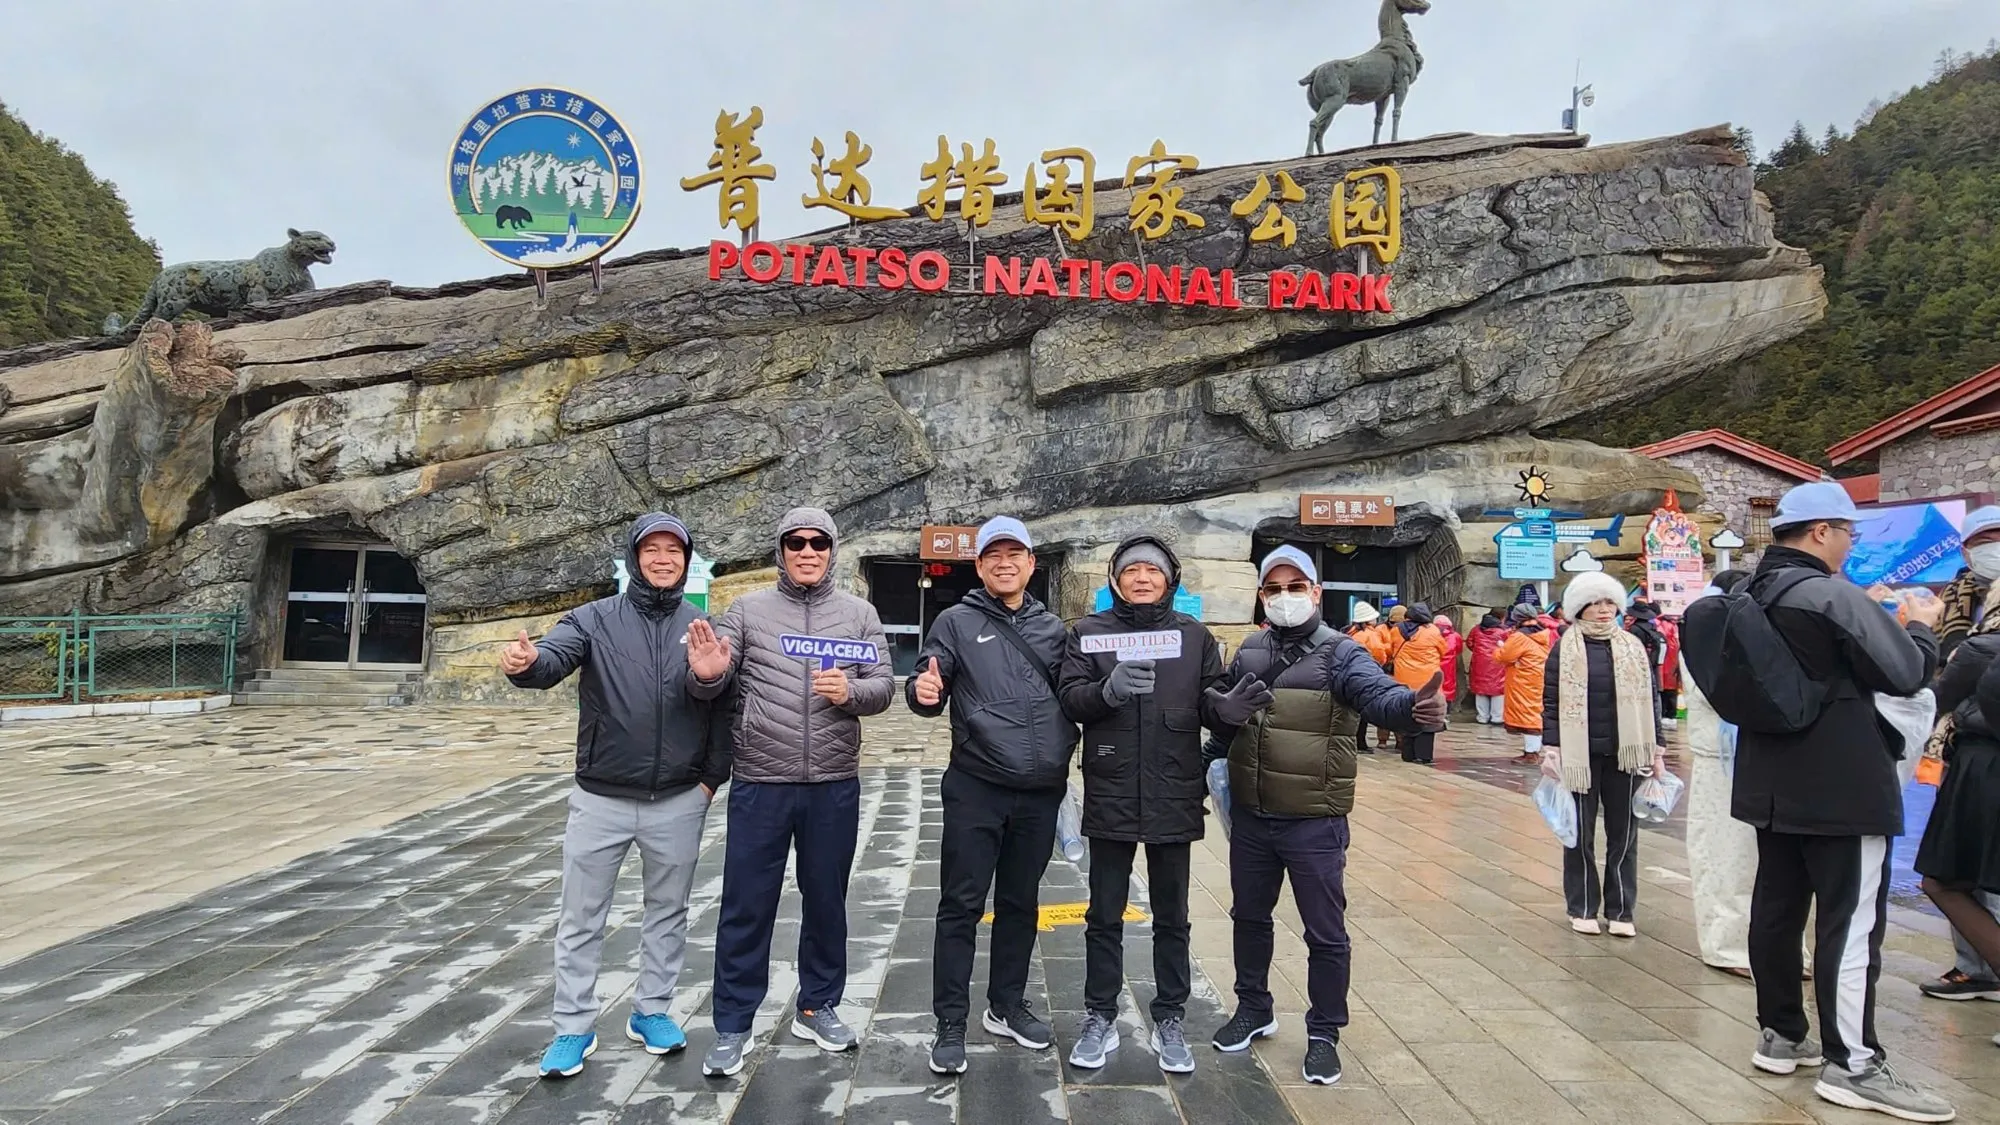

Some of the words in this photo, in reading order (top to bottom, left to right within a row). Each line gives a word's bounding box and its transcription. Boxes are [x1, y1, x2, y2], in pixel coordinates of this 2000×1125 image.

[453, 92, 636, 190] 香格里拉普达措国家公园
[680, 105, 1401, 264] 普达措国家公园
[708, 240, 950, 291] POTATSO
[983, 255, 1242, 308] NATIONAL
[1269, 269, 1393, 313] PARK
[1334, 501, 1378, 513] 售票处
[782, 637, 876, 661] VIGLACERA
[1084, 636, 1137, 650] UNITED
[1139, 633, 1178, 647] TILES
